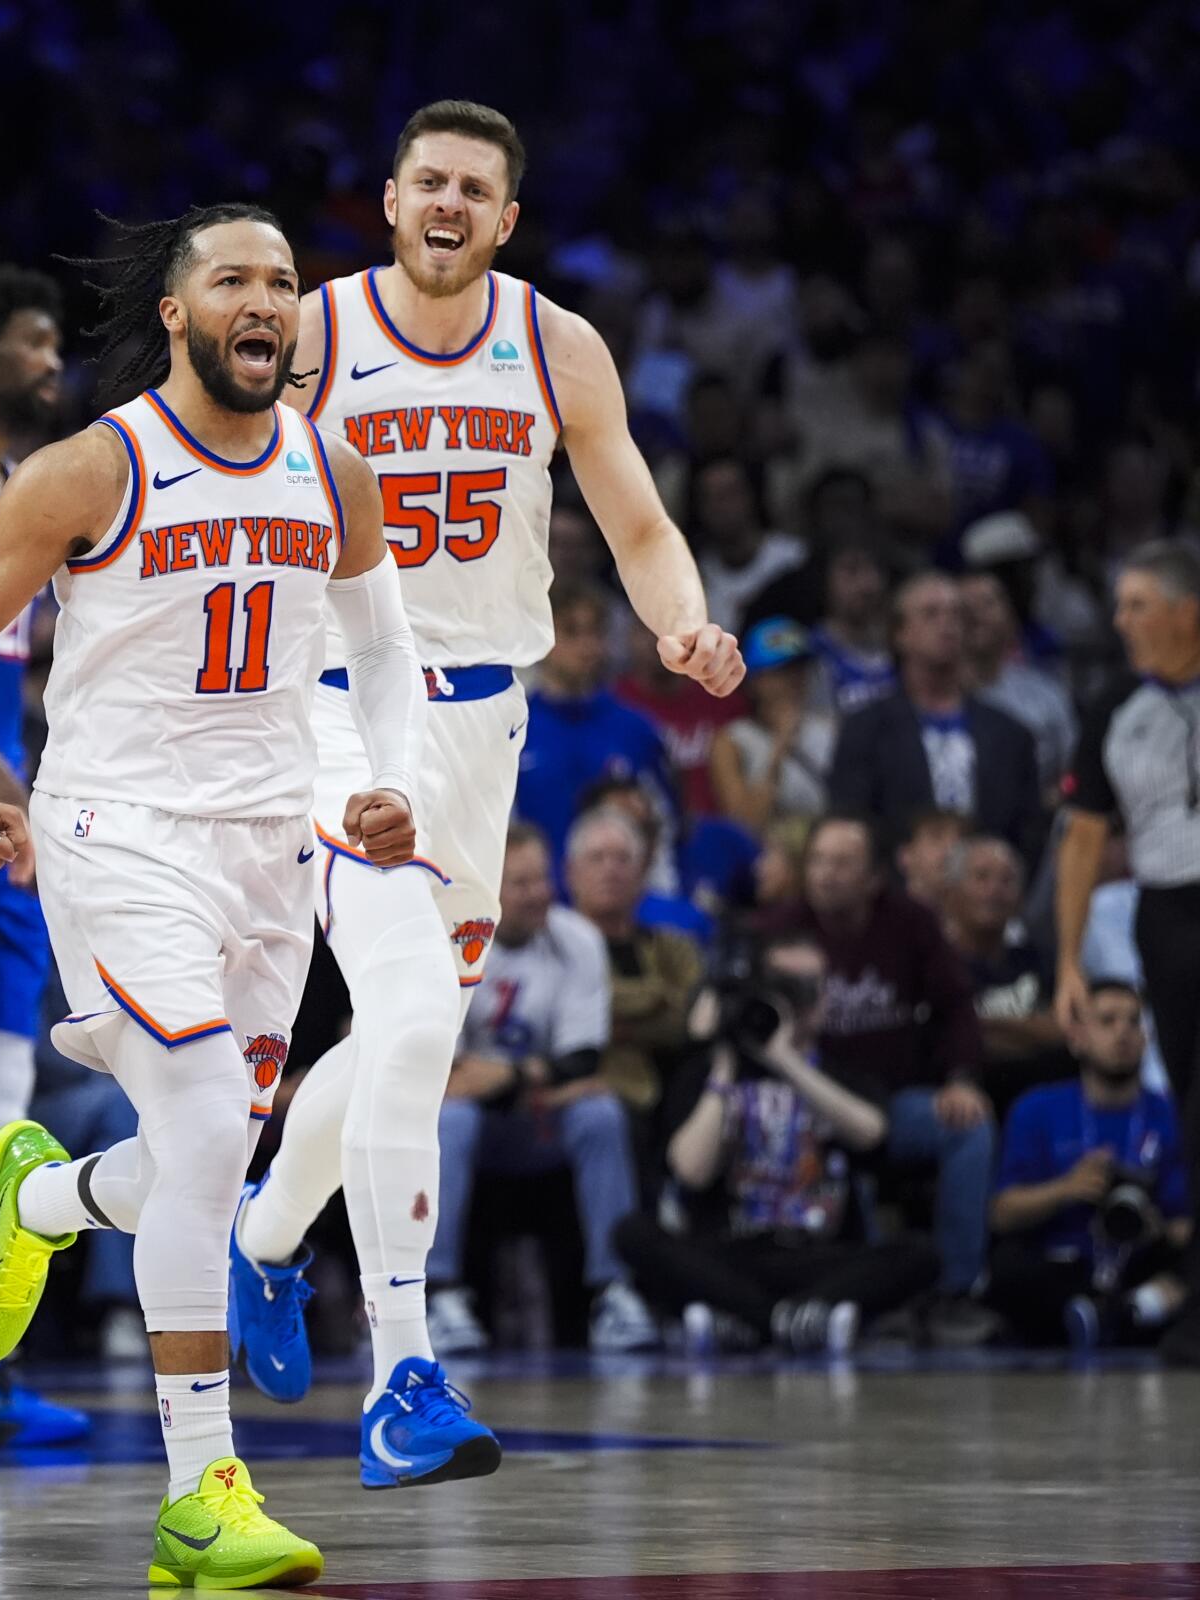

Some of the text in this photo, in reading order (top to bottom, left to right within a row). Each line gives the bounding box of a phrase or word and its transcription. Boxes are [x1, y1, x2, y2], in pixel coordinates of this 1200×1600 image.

[490, 361, 525, 373] sphere
[343, 405, 536, 457] NEW YORK
[286, 474, 318, 485] sphere
[378, 467, 507, 569] 55
[138, 516, 333, 581] NEW YORK
[195, 580, 275, 694] 11
